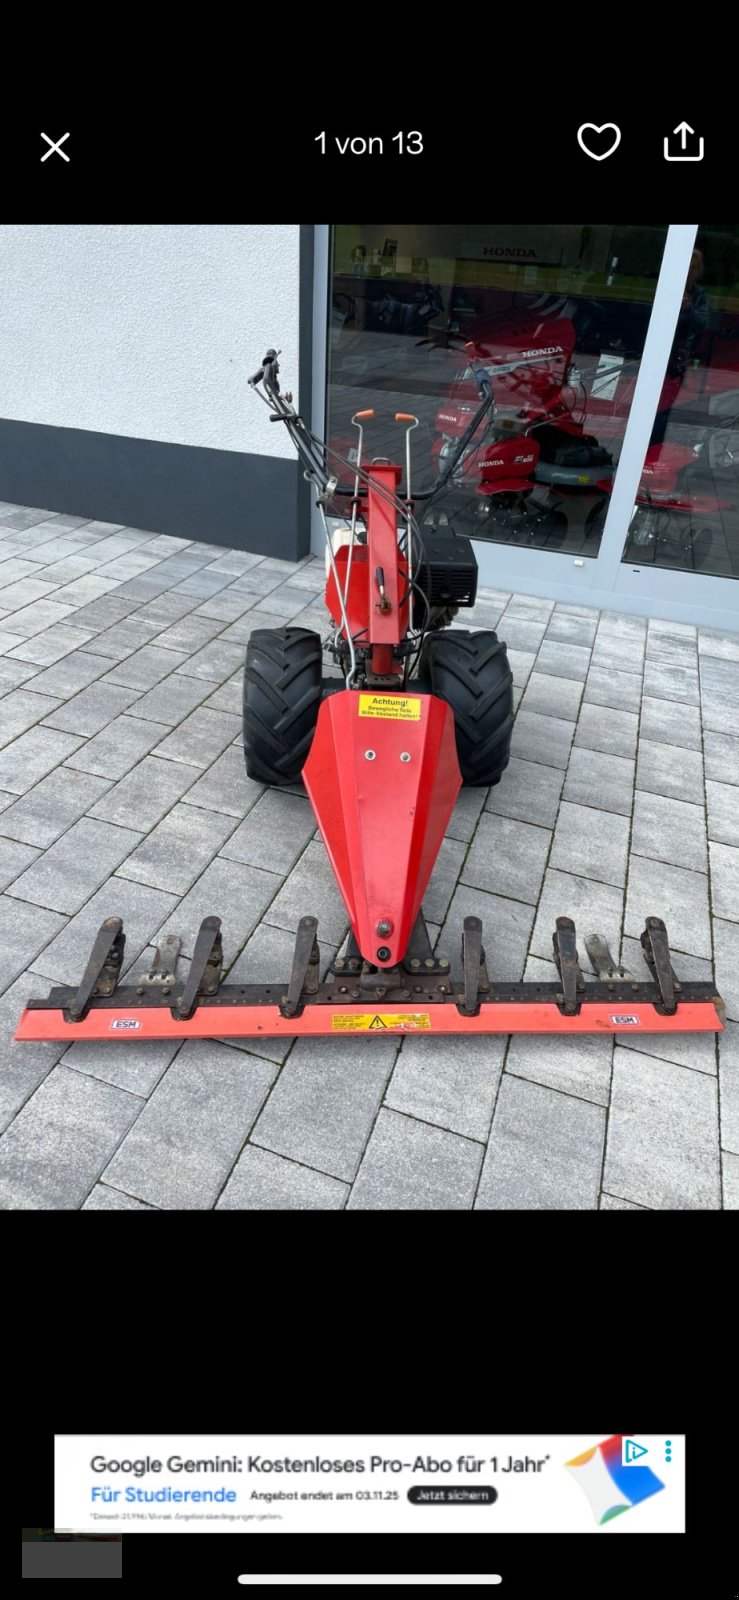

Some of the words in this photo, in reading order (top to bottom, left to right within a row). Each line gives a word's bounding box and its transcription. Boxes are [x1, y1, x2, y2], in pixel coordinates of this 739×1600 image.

[482, 246, 537, 258] HONDA
[521, 346, 564, 358] HONDA
[438, 414, 457, 422] HONDA
[478, 459, 504, 468] HONDA
[372, 697, 409, 707] Achtung!
[115, 1020, 137, 1028] ESM
[614, 1016, 635, 1024] ESM
